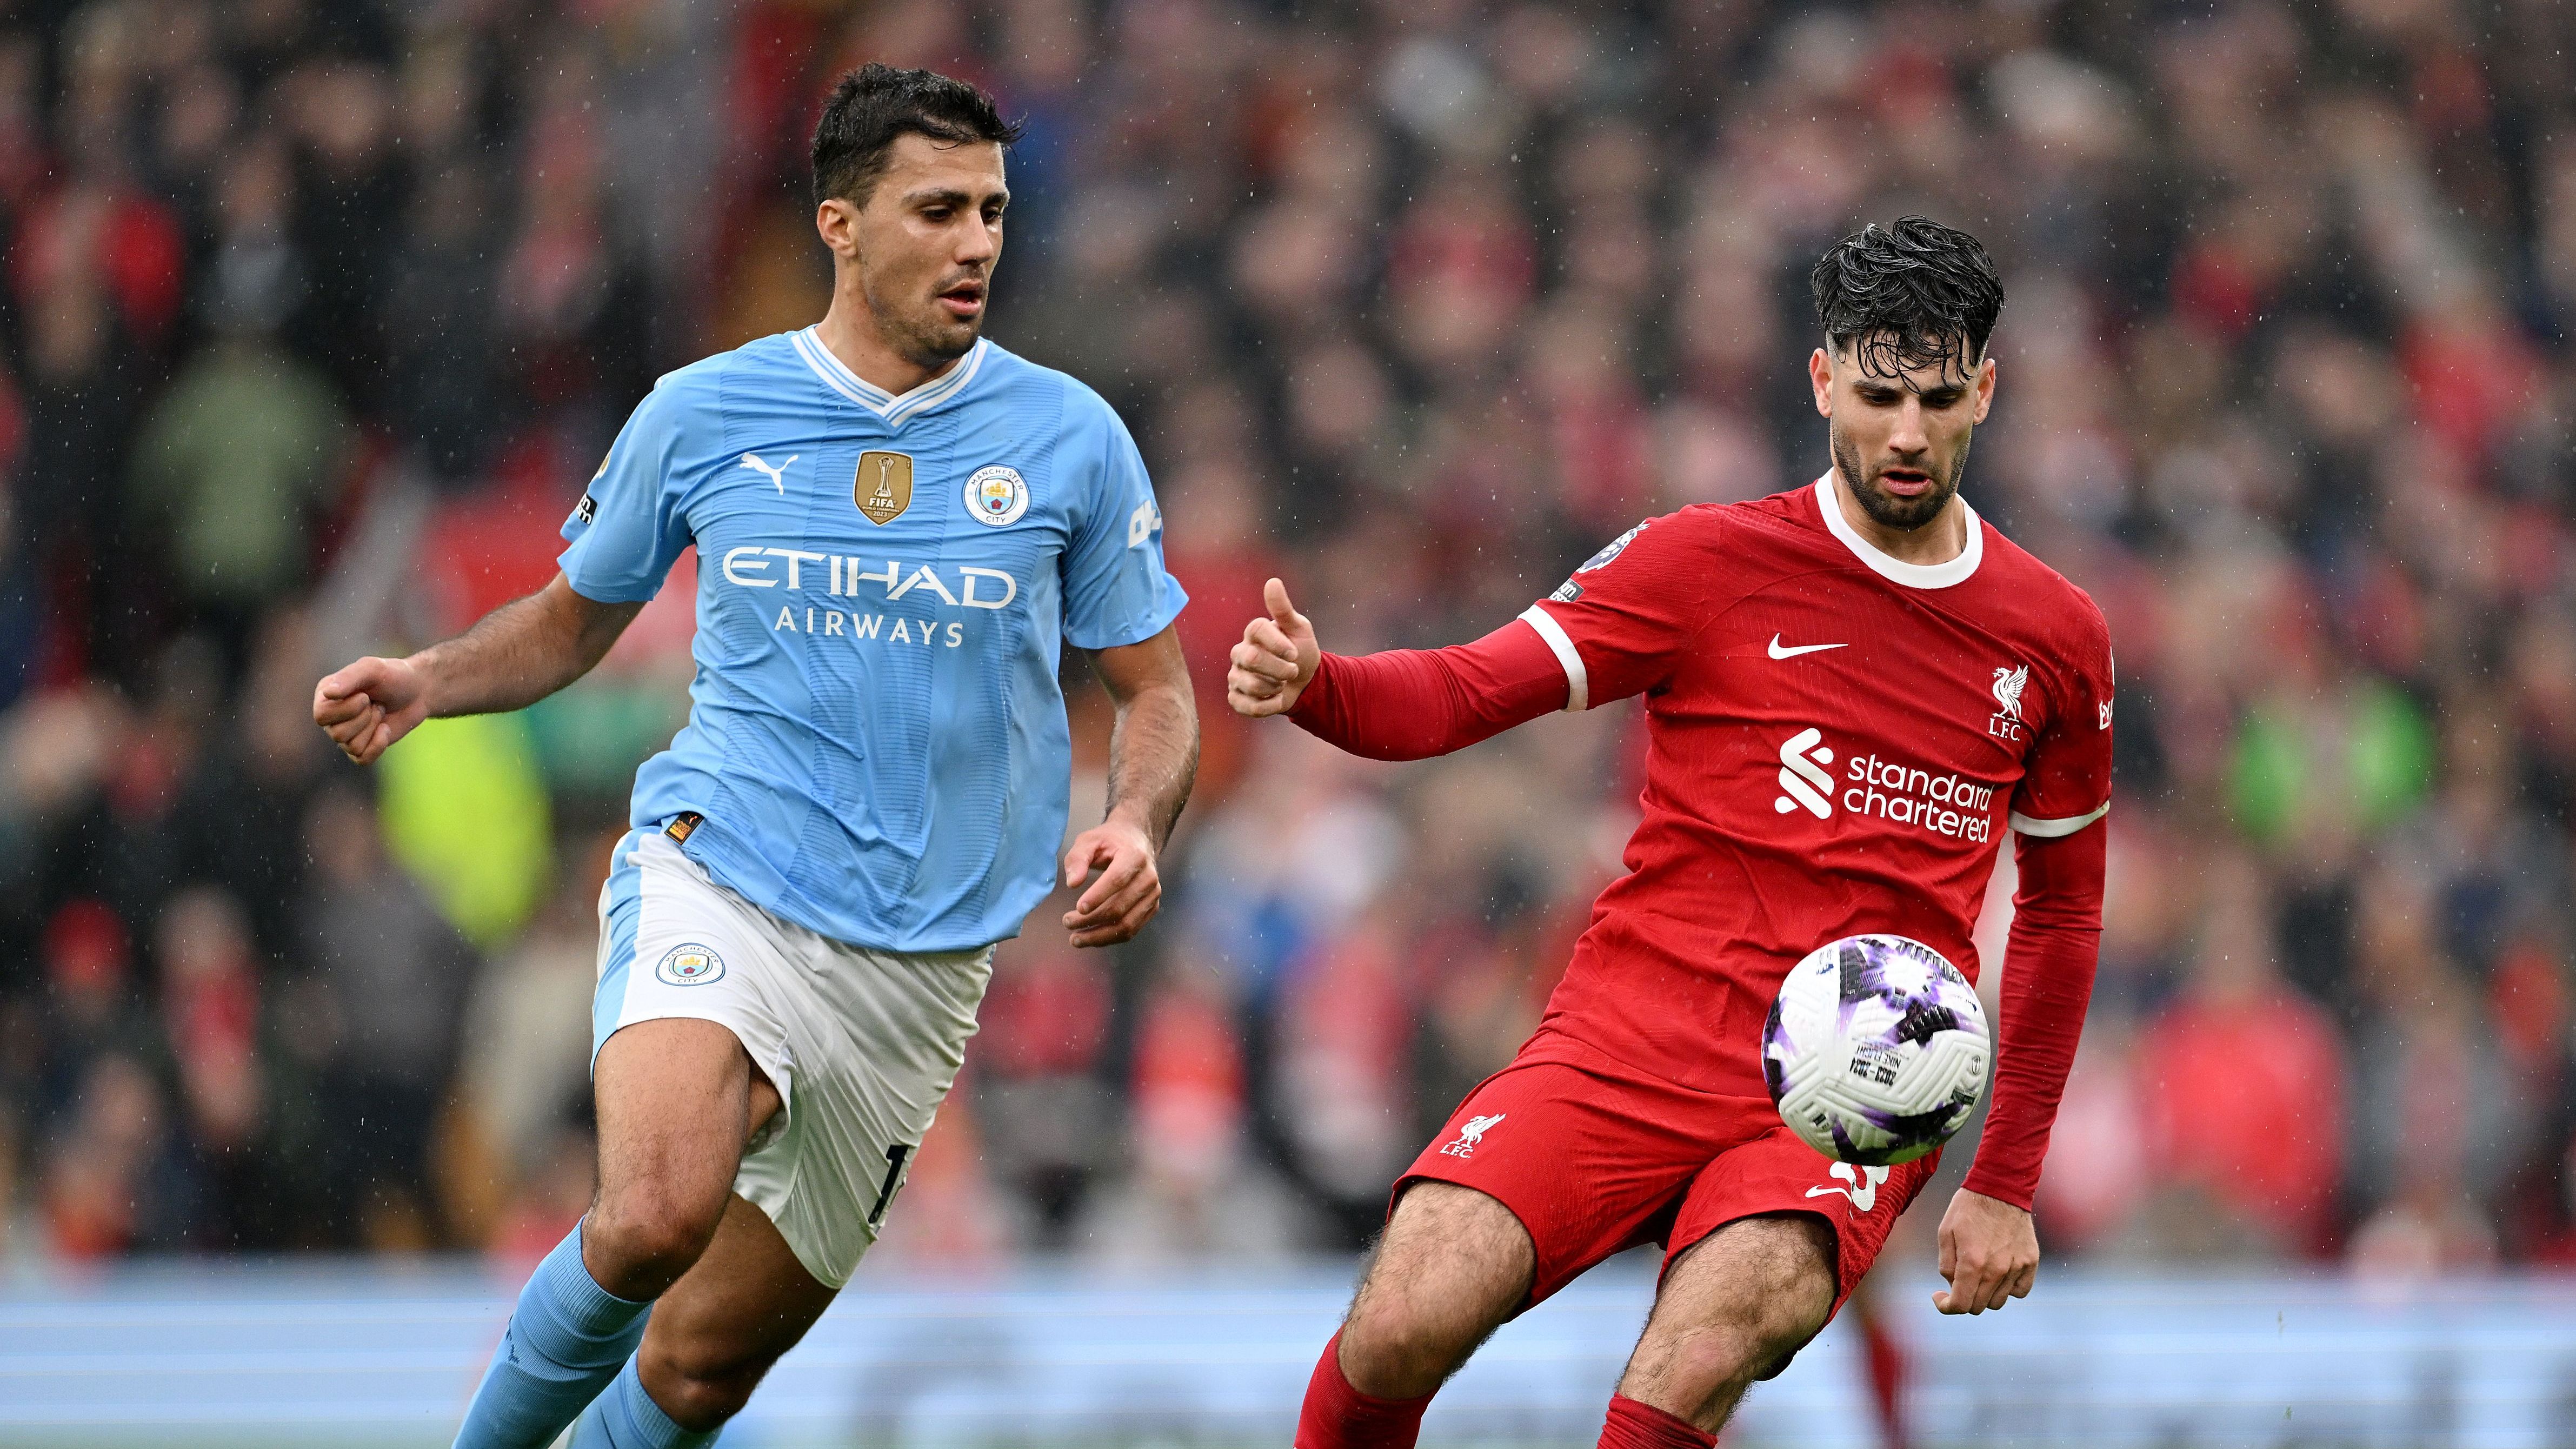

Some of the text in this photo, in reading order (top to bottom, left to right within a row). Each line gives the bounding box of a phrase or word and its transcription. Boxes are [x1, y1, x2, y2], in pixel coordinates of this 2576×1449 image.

[971, 469, 1023, 490] MANCHESTER
[869, 497, 894, 508] FIFA
[722, 547, 1017, 609] ETIHAD
[774, 606, 963, 648] AIRWAYS
[1847, 754, 1995, 812] standard
[1843, 785, 1991, 843] chartered
[665, 947, 719, 963] MANCHESTER
